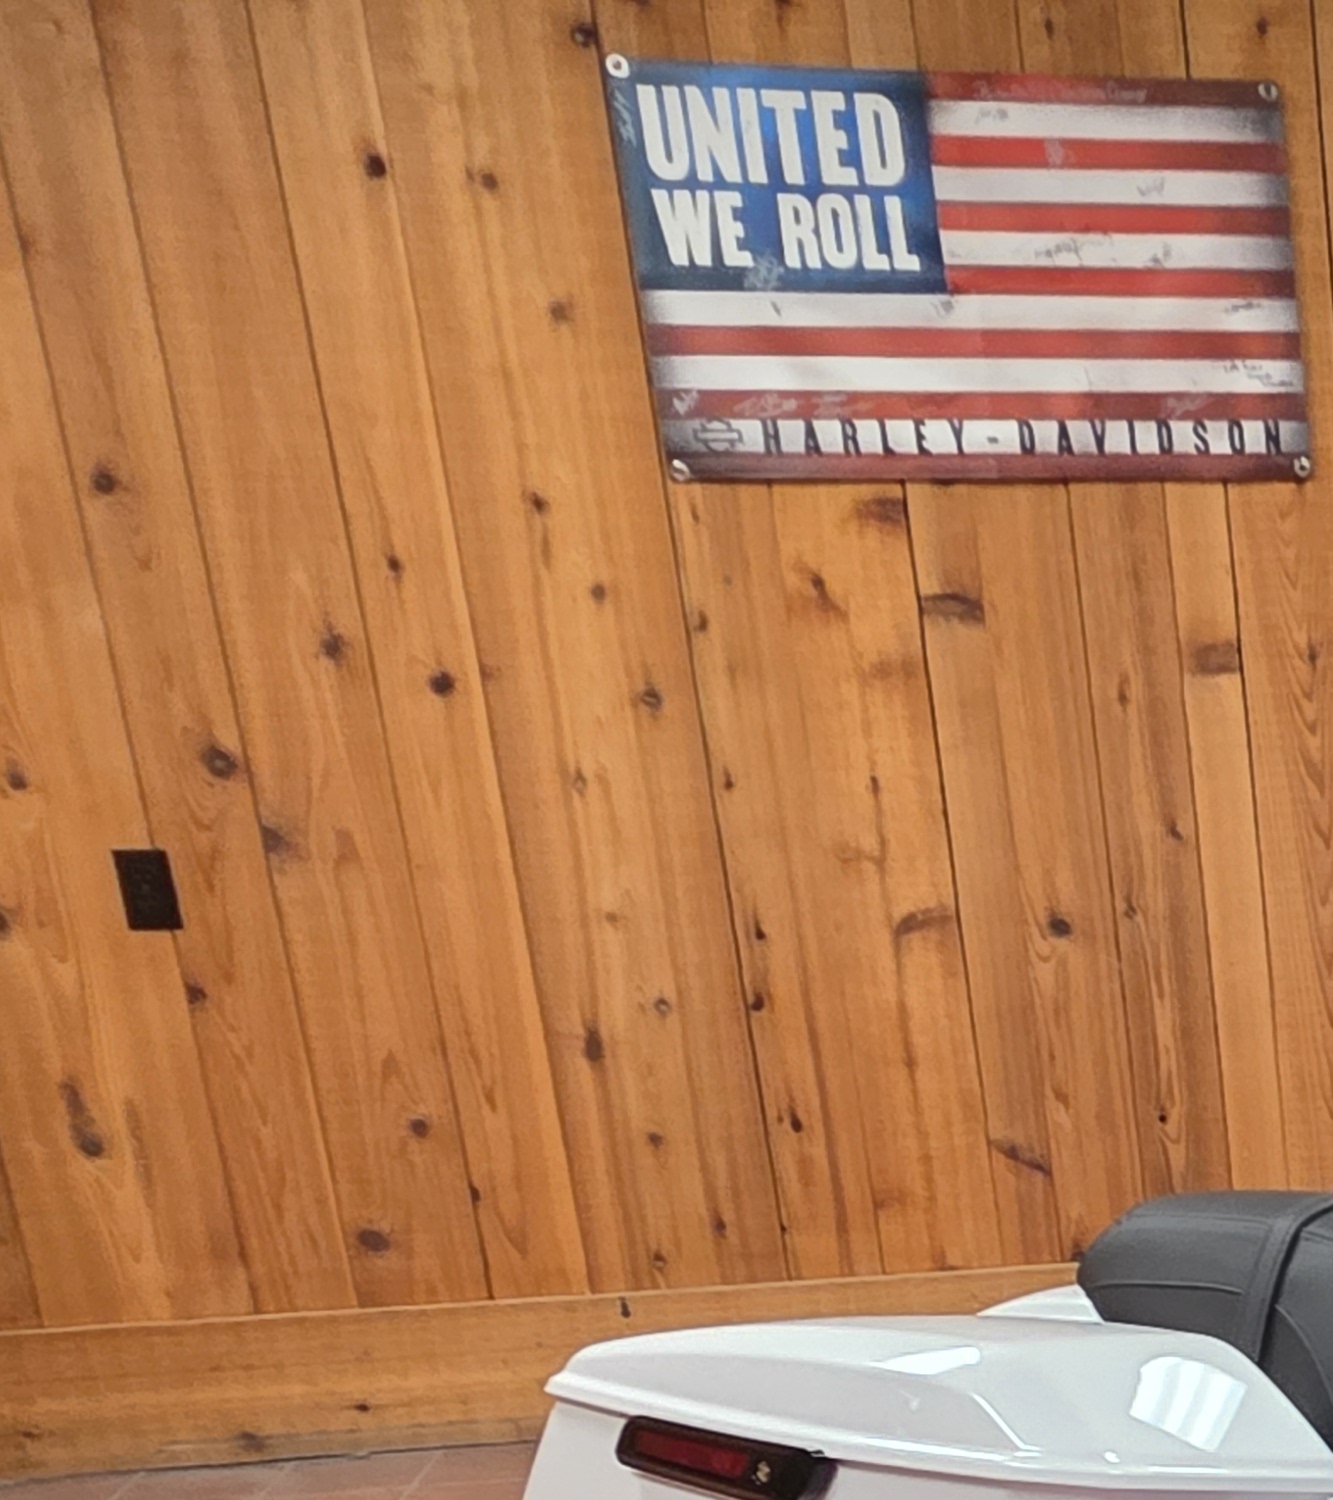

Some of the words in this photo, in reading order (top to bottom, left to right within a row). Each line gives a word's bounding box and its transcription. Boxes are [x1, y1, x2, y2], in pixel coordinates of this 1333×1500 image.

[636, 84, 905, 187] UNITED
[651, 189, 754, 267] WE
[777, 193, 920, 271] ROLL
[763, 418, 1286, 457] HARLEY-DAVIDSON
